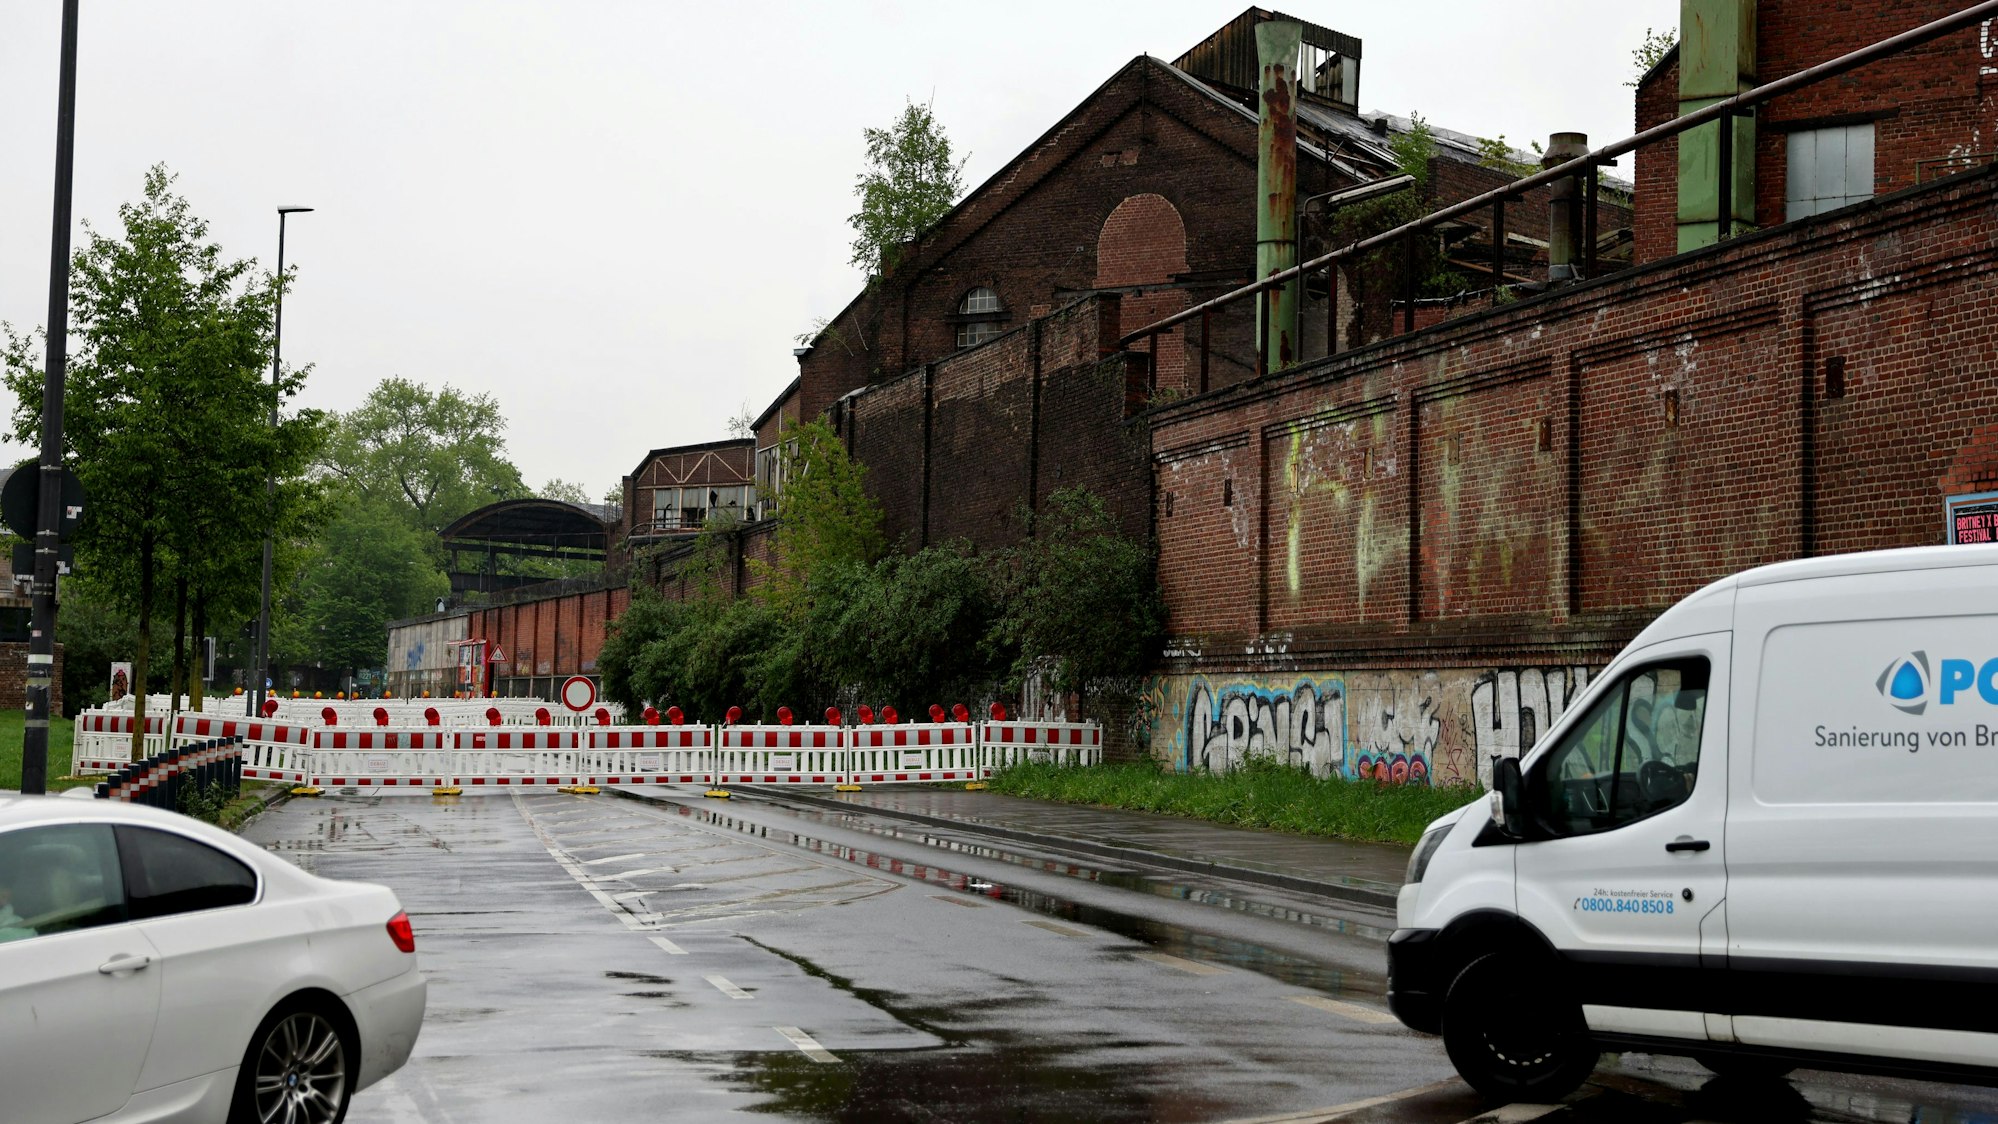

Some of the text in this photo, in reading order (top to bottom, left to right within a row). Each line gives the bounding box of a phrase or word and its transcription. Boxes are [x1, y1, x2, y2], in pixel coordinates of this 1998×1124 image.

[1956, 515, 1985, 530] BRITNEY
[1986, 514, 1992, 527] X
[1958, 528, 1992, 543] FESTIVAL
[1815, 725, 1919, 753] Sanierung
[1927, 731, 1966, 746] von
[1593, 888, 1673, 898] 24h: kostenfreier Service
